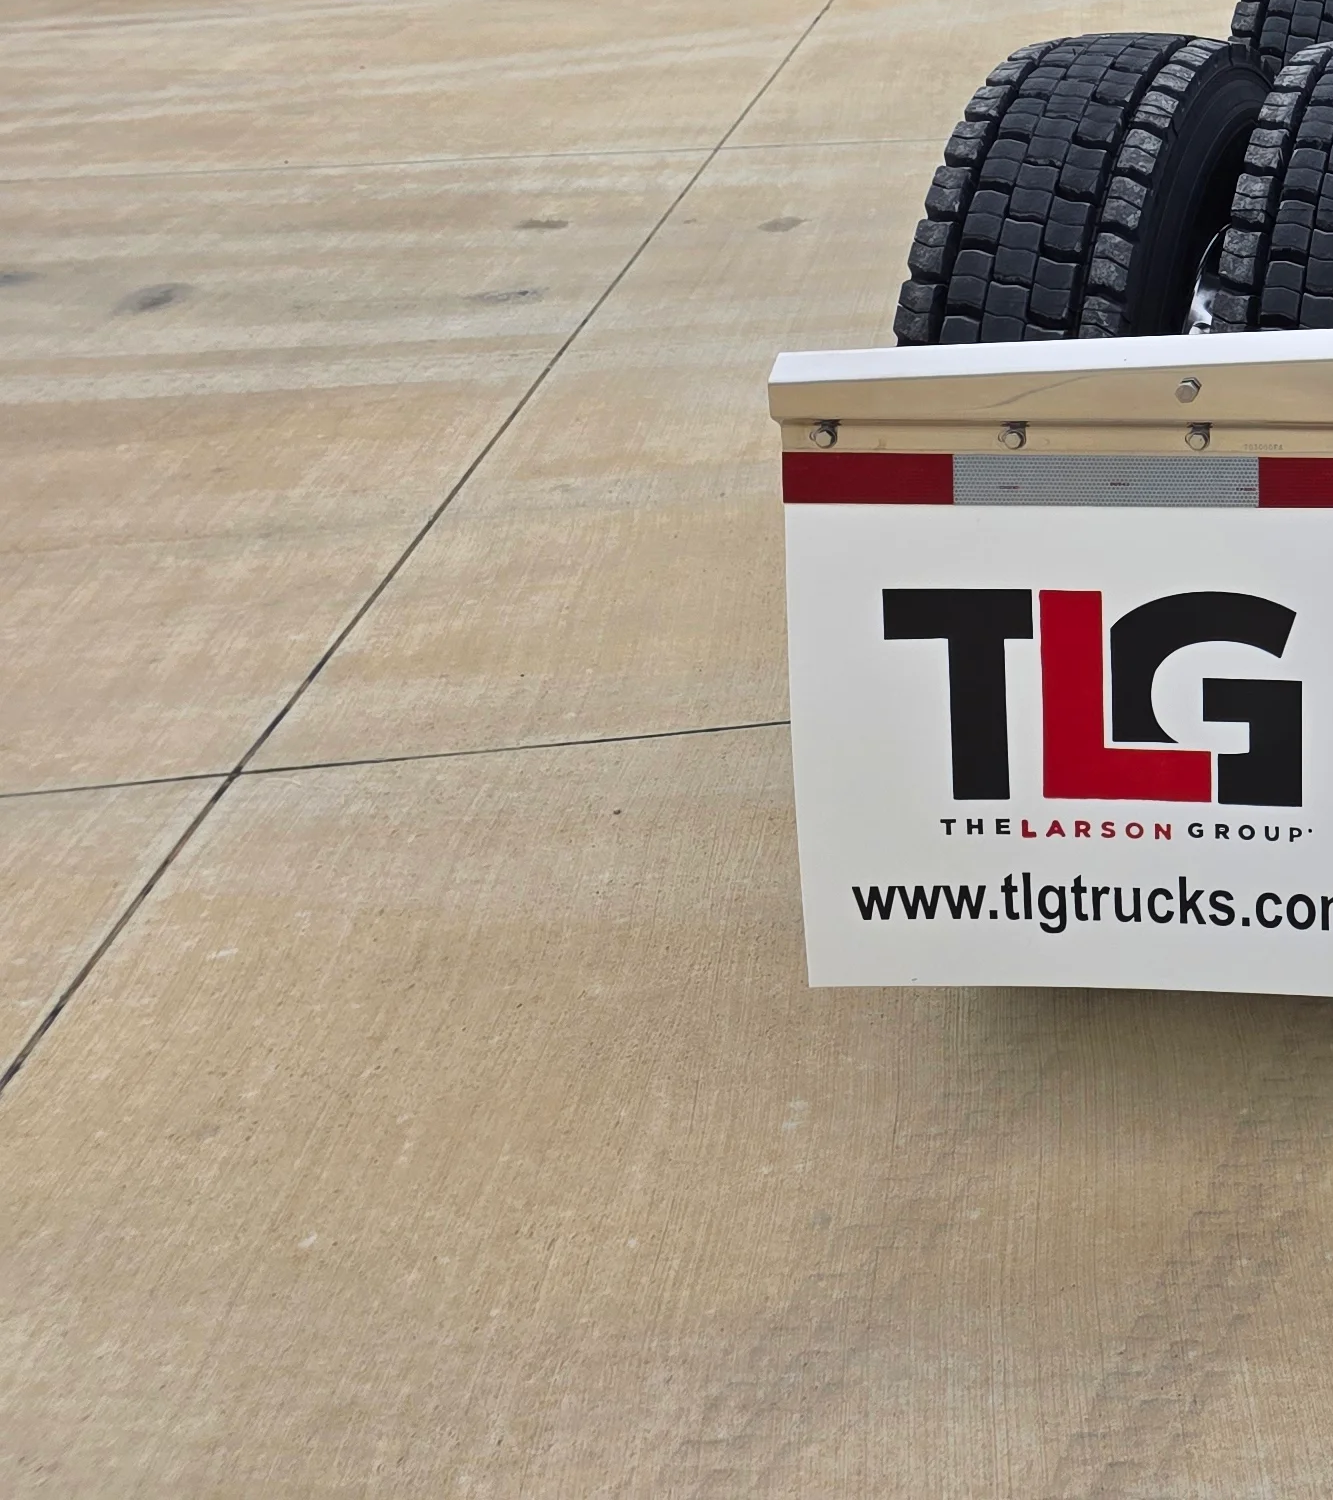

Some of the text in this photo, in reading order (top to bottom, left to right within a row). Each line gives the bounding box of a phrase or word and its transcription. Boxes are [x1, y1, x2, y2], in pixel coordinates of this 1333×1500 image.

[881, 588, 1303, 808] TLG
[939, 818, 1303, 843] THE LARSON GROUP
